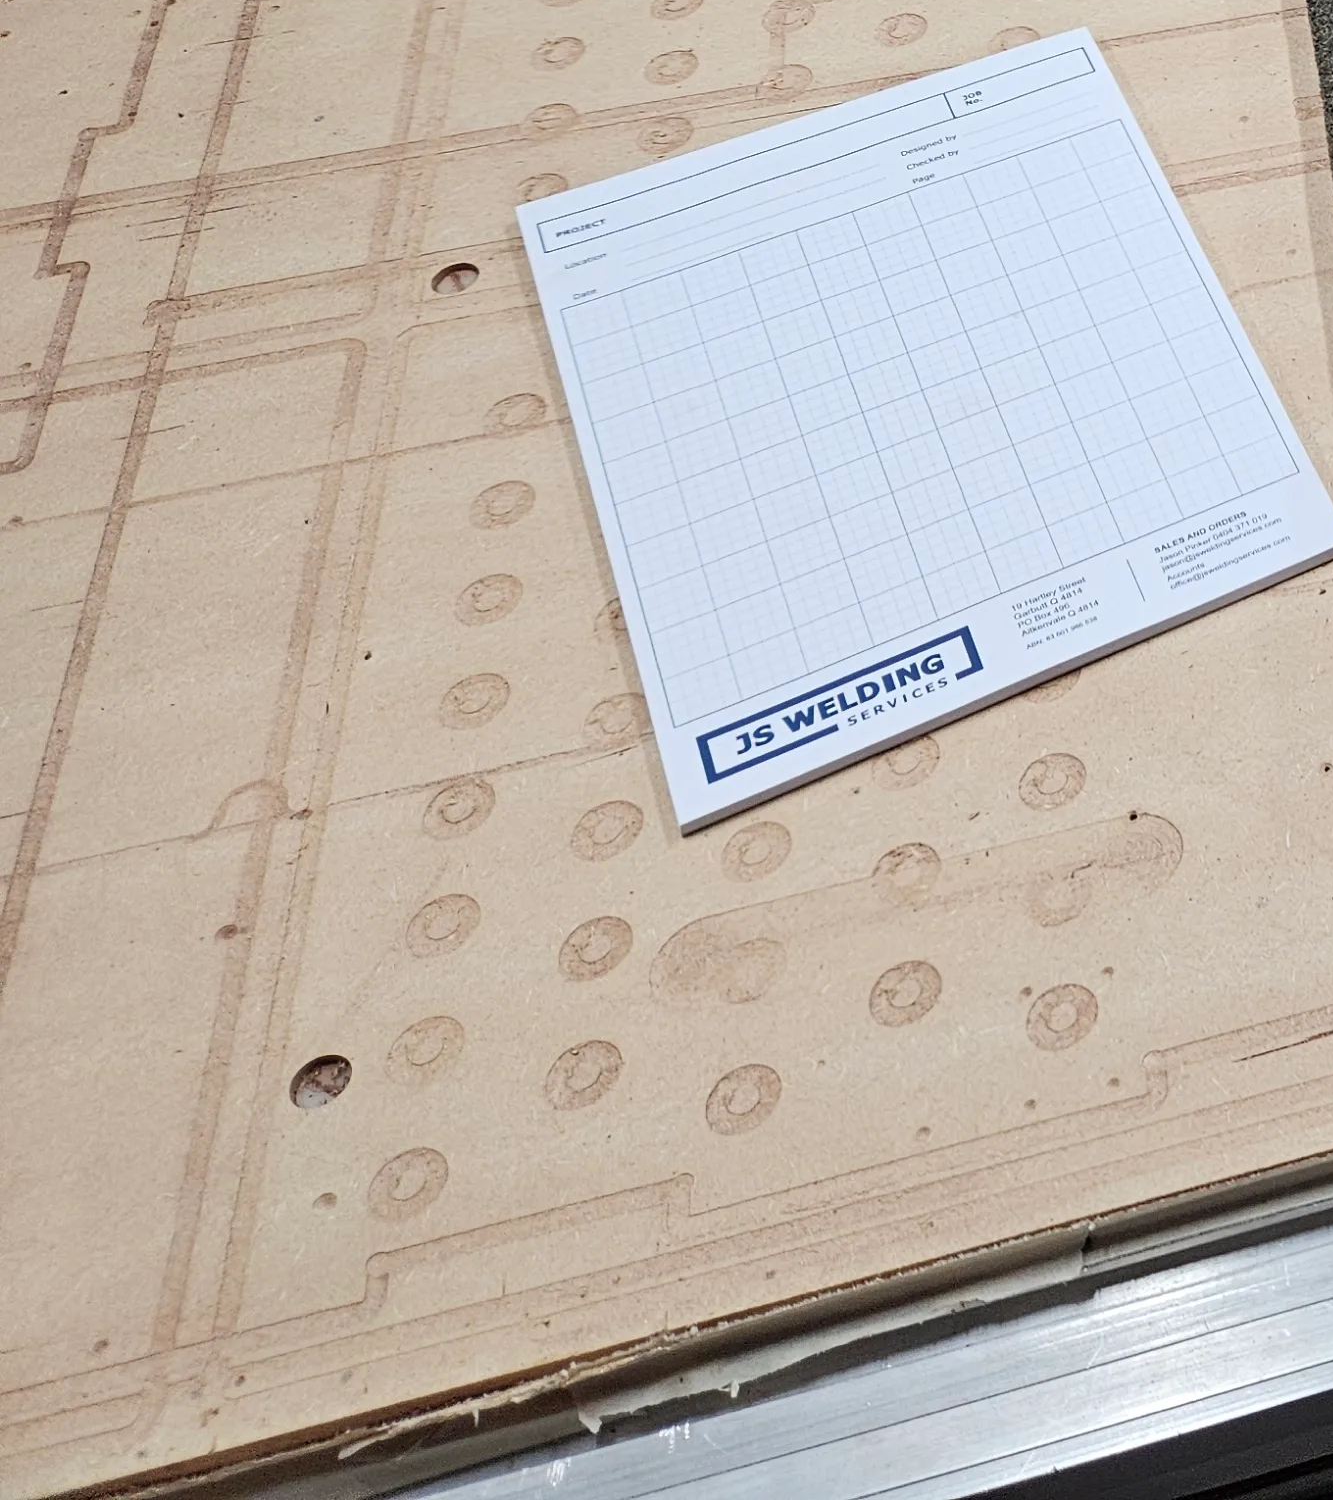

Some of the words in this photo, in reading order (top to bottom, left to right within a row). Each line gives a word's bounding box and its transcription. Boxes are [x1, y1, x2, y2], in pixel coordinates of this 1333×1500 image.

[963, 90, 982, 101] JOB
[901, 139, 943, 156] Designed
[945, 135, 957, 143] by
[906, 154, 946, 170] Checked
[912, 173, 935, 184] Page
[556, 219, 606, 238] PROJECT
[564, 253, 607, 269] Location
[573, 289, 597, 300] Date
[1154, 537, 1185, 554] SALES
[1187, 527, 1206, 540] AND
[1208, 511, 1247, 532] ORDERS
[1159, 550, 1184, 563] Jason
[1185, 538, 1211, 552] Pinker
[1236, 521, 1250, 531] 371
[1252, 513, 1268, 524] 019
[1167, 562, 1205, 581] Accounts
[1011, 603, 1022, 612] 19
[1024, 590, 1056, 607] Hartley
[1059, 577, 1086, 592] Street
[1013, 603, 1048, 620] Garbutt
[1061, 587, 1083, 601] 4814
[1017, 618, 1032, 629] PO
[1034, 611, 1052, 621] Box
[1053, 603, 1070, 614] 496
[1021, 615, 1066, 637] Aitkenvale
[1078, 599, 1099, 613] 4814
[735, 723, 775, 755] JS
[782, 653, 945, 733] WELDING
[847, 677, 948, 727] SERVICES
